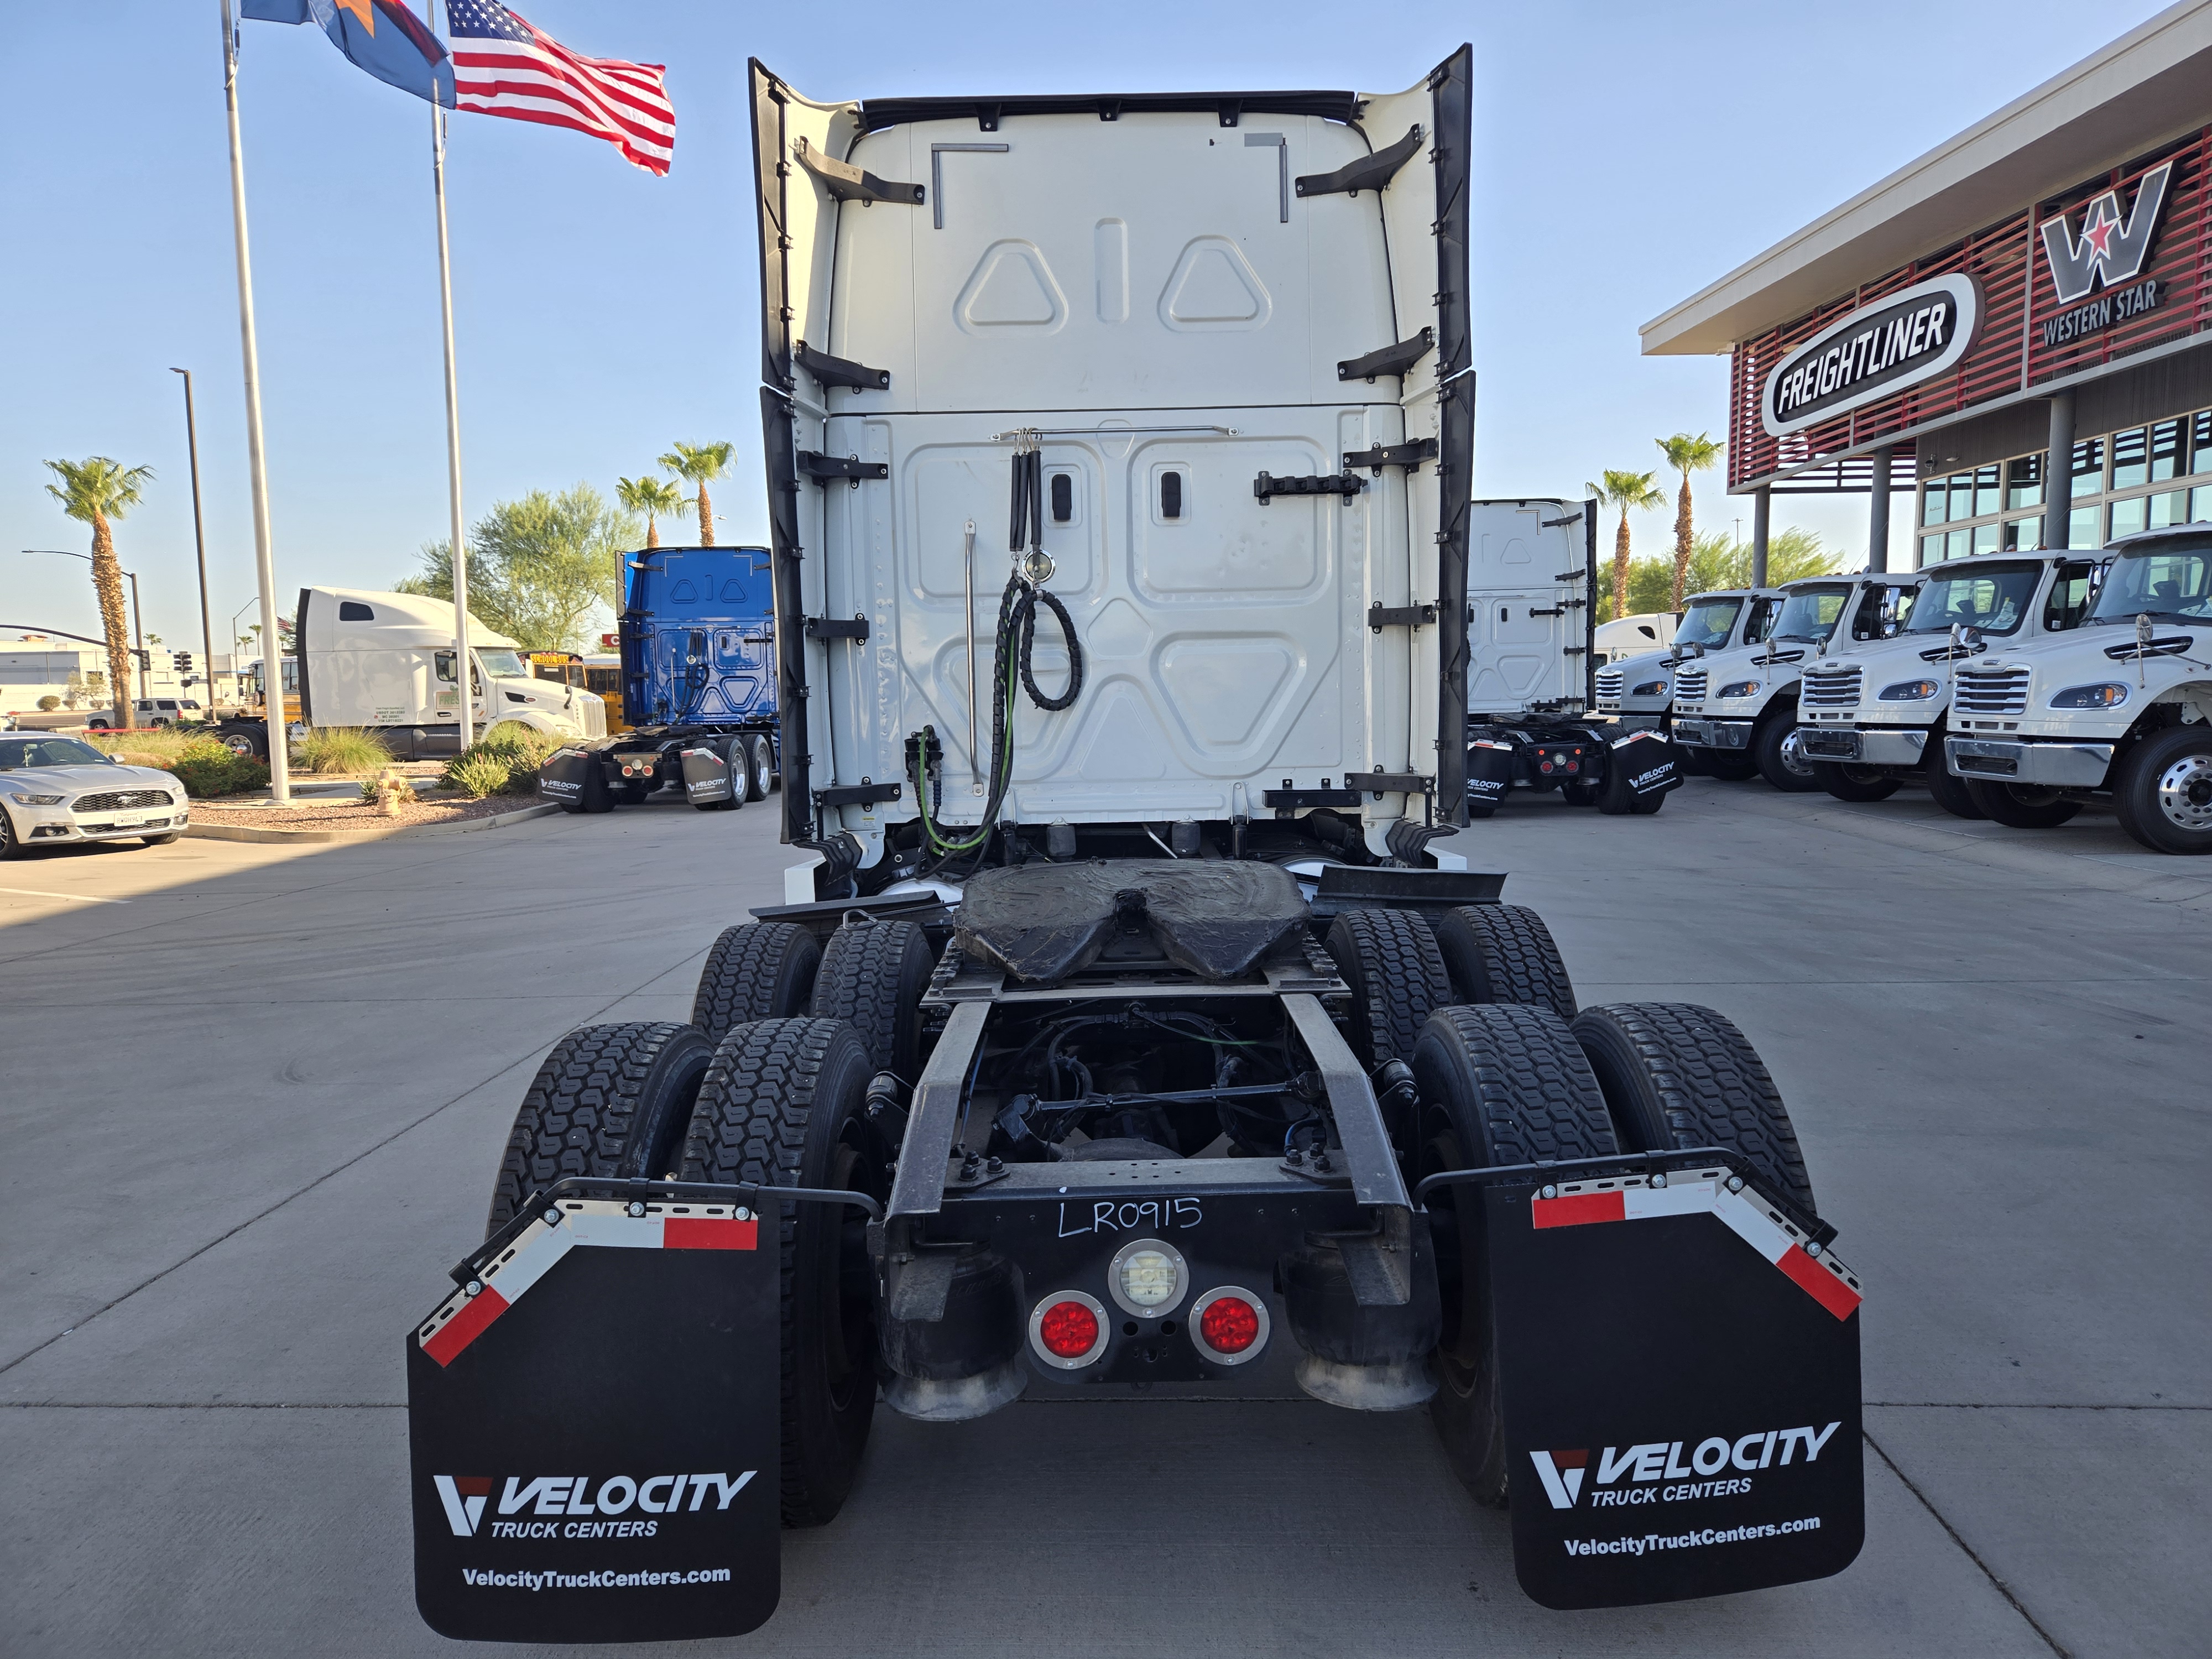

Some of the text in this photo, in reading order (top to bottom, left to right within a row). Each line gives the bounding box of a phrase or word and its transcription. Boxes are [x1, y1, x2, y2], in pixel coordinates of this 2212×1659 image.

[2043, 280, 2156, 347] WESTERN STAR
[1778, 302, 1946, 414] FREIGHTLINER
[531, 655, 568, 664] SCHOOL BUS
[439, 695, 460, 705] FRES
[548, 780, 582, 790] VELOCITY
[696, 778, 727, 788] VELOCITY
[1639, 761, 1674, 782] VELOCITY
[1058, 1197, 1203, 1238] LR0915
[1597, 1421, 1842, 1484] VELOCITY
[498, 1470, 758, 1515] VELOCITY
[1591, 1477, 1752, 1507] TRUCK CENTERS
[491, 1520, 658, 1538] TRUCK CENTERS
[1564, 1516, 1821, 1556] VelocityTruckCenters.com
[462, 1566, 731, 1592] VelocityTruckCenters.com
